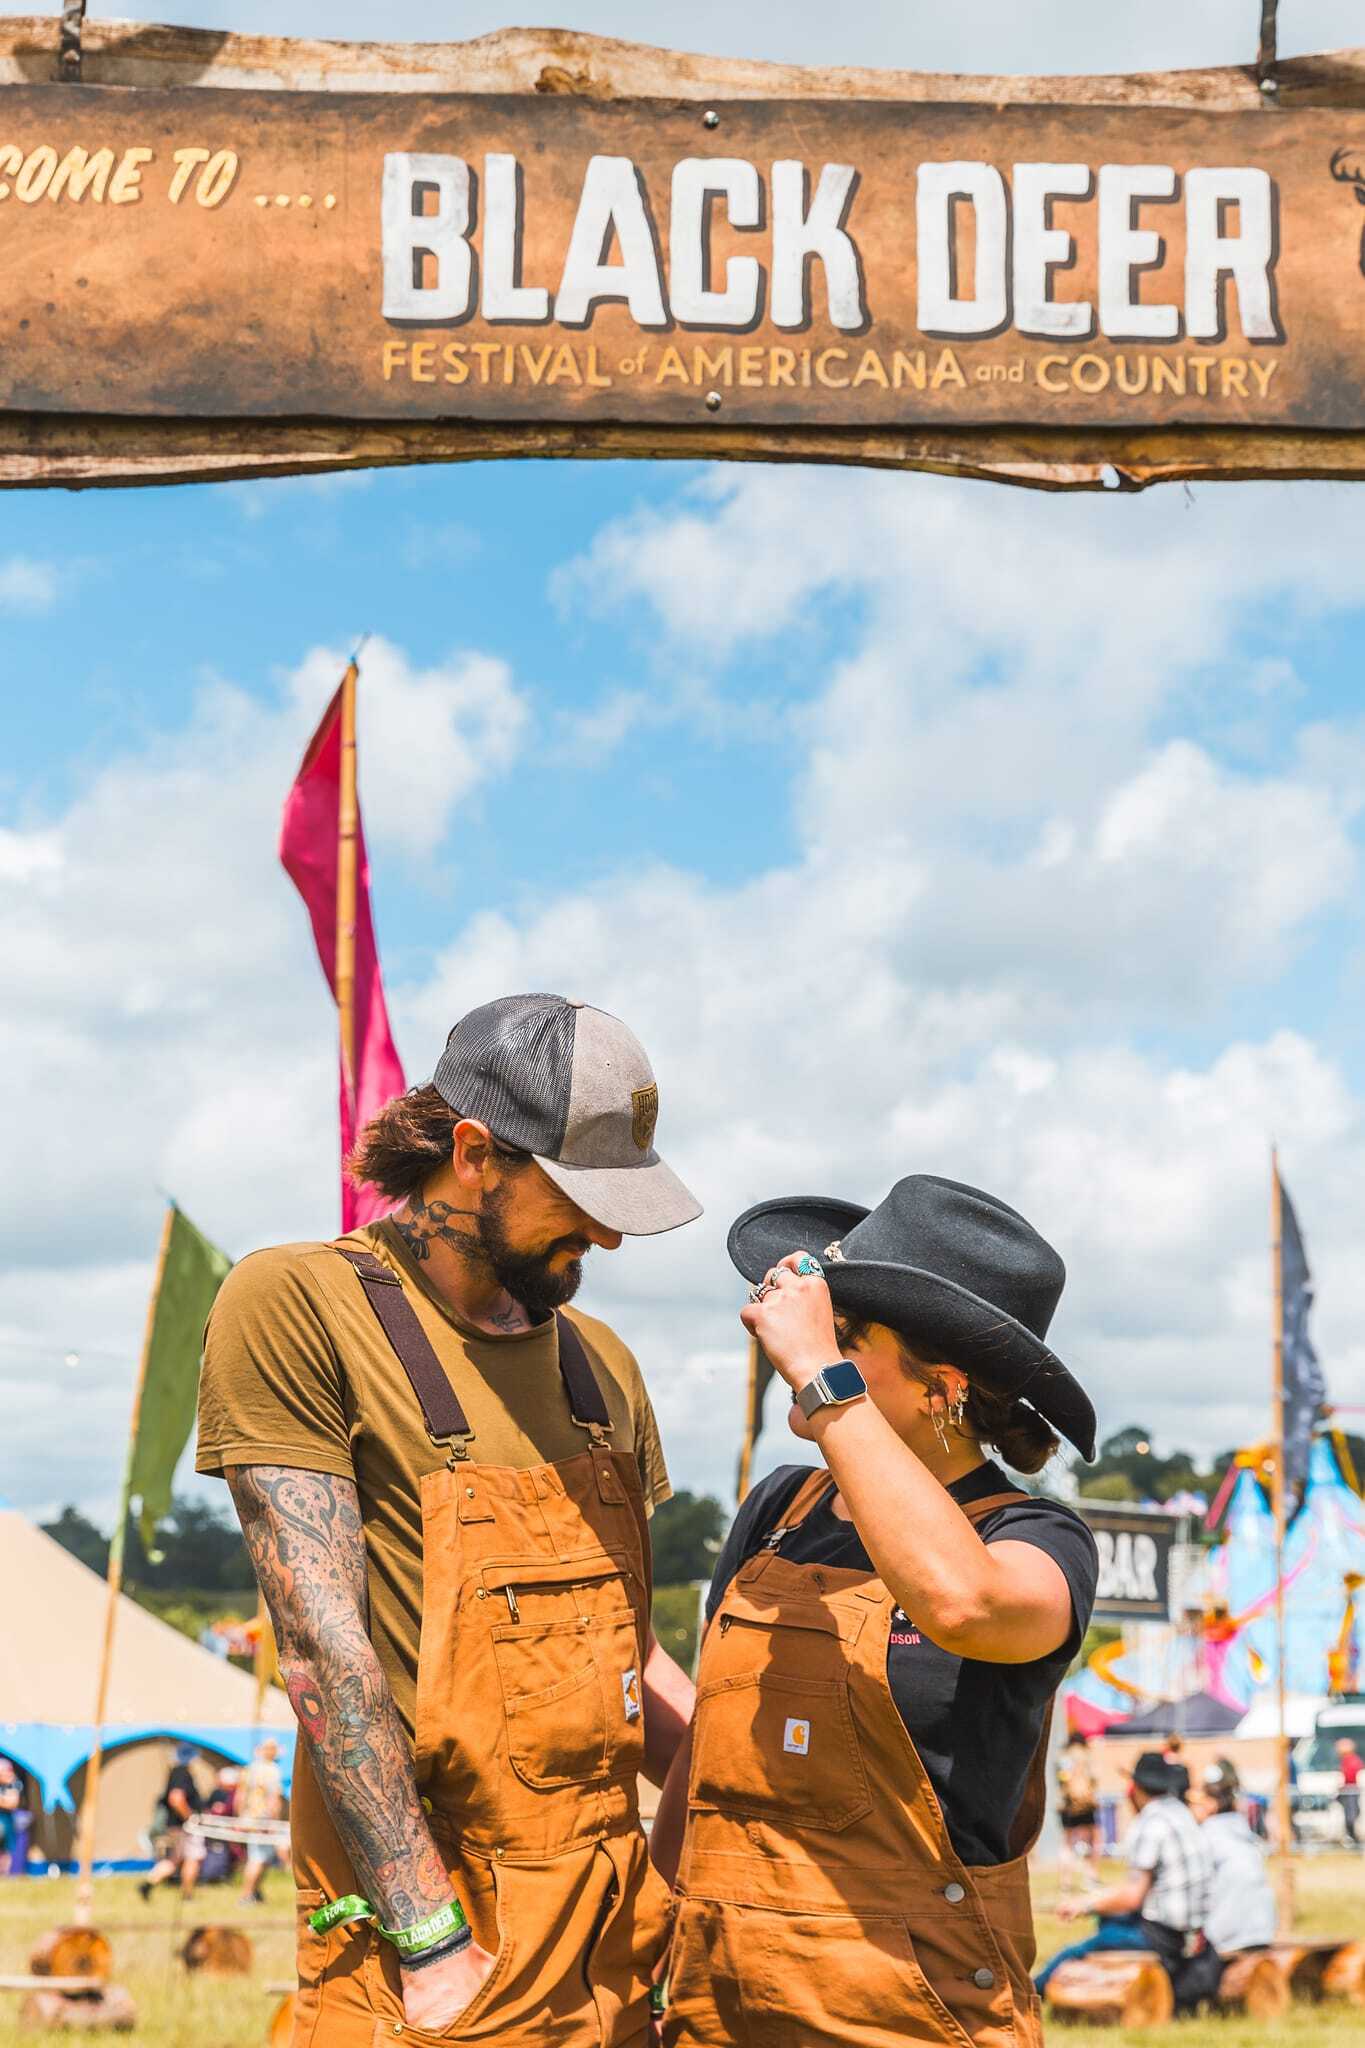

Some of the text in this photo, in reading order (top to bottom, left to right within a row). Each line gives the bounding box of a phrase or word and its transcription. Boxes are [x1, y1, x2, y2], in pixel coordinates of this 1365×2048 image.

[168, 147, 238, 208] TO
[380, 152, 1282, 342] BLACK DEER
[382, 341, 1278, 398] FESTIVAL of AMERICANA and COUNTRY
[1094, 1529, 1158, 1601] BAR
[398, 1908, 455, 1947] BLACK DEER
